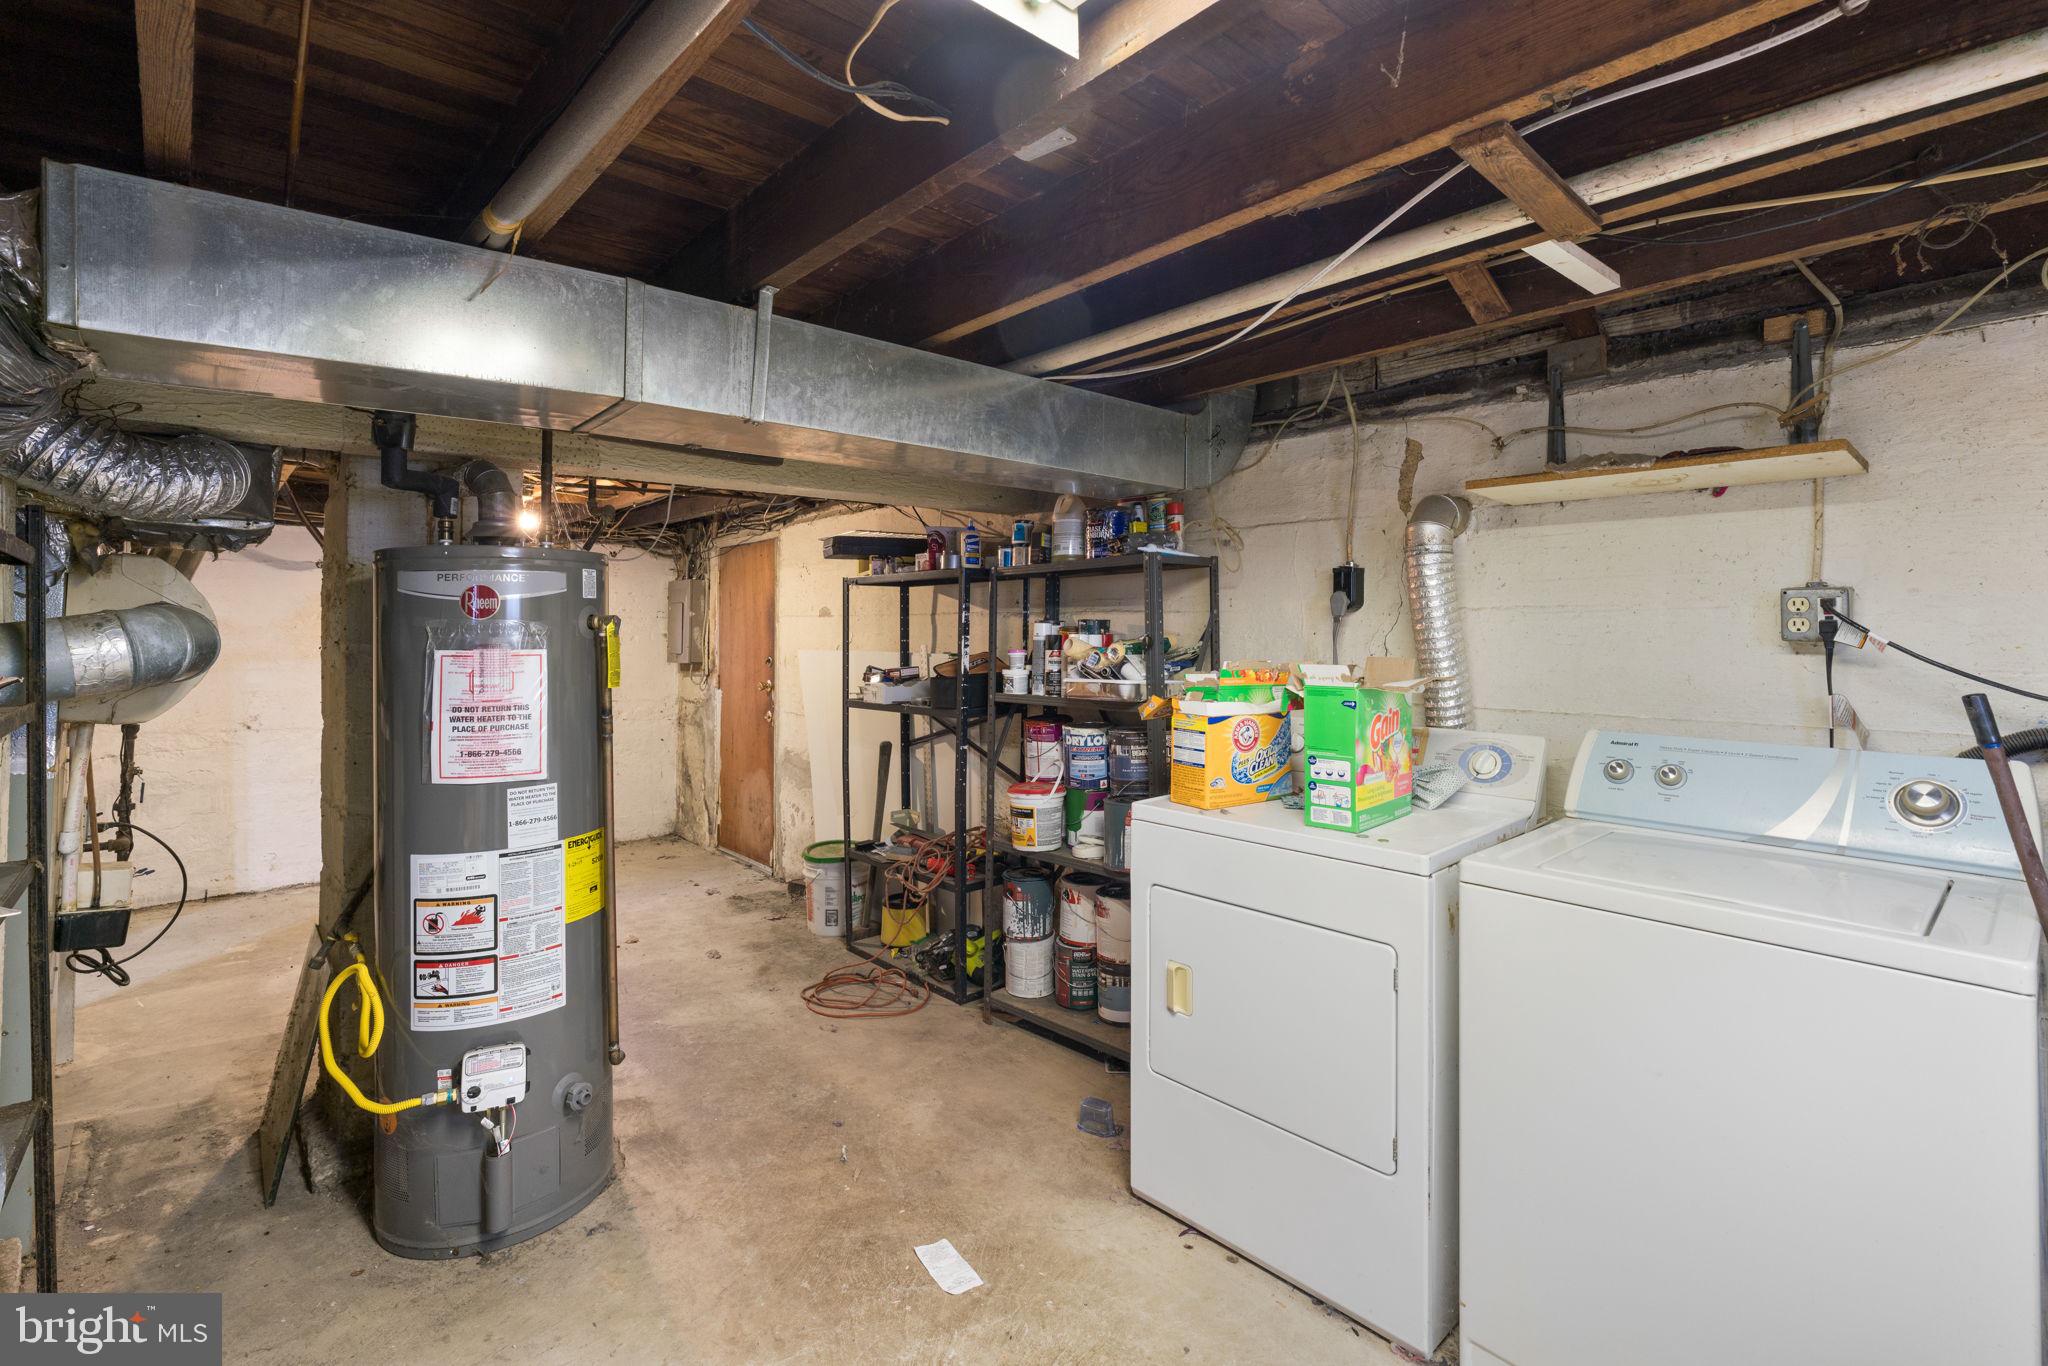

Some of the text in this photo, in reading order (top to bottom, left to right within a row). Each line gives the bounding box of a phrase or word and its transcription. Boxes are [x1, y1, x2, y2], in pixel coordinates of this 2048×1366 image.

[464, 590, 498, 614] Rheem
[481, 705, 511, 713] RETURN
[490, 723, 529, 732] PURCHASE
[1370, 708, 1401, 752] Gain
